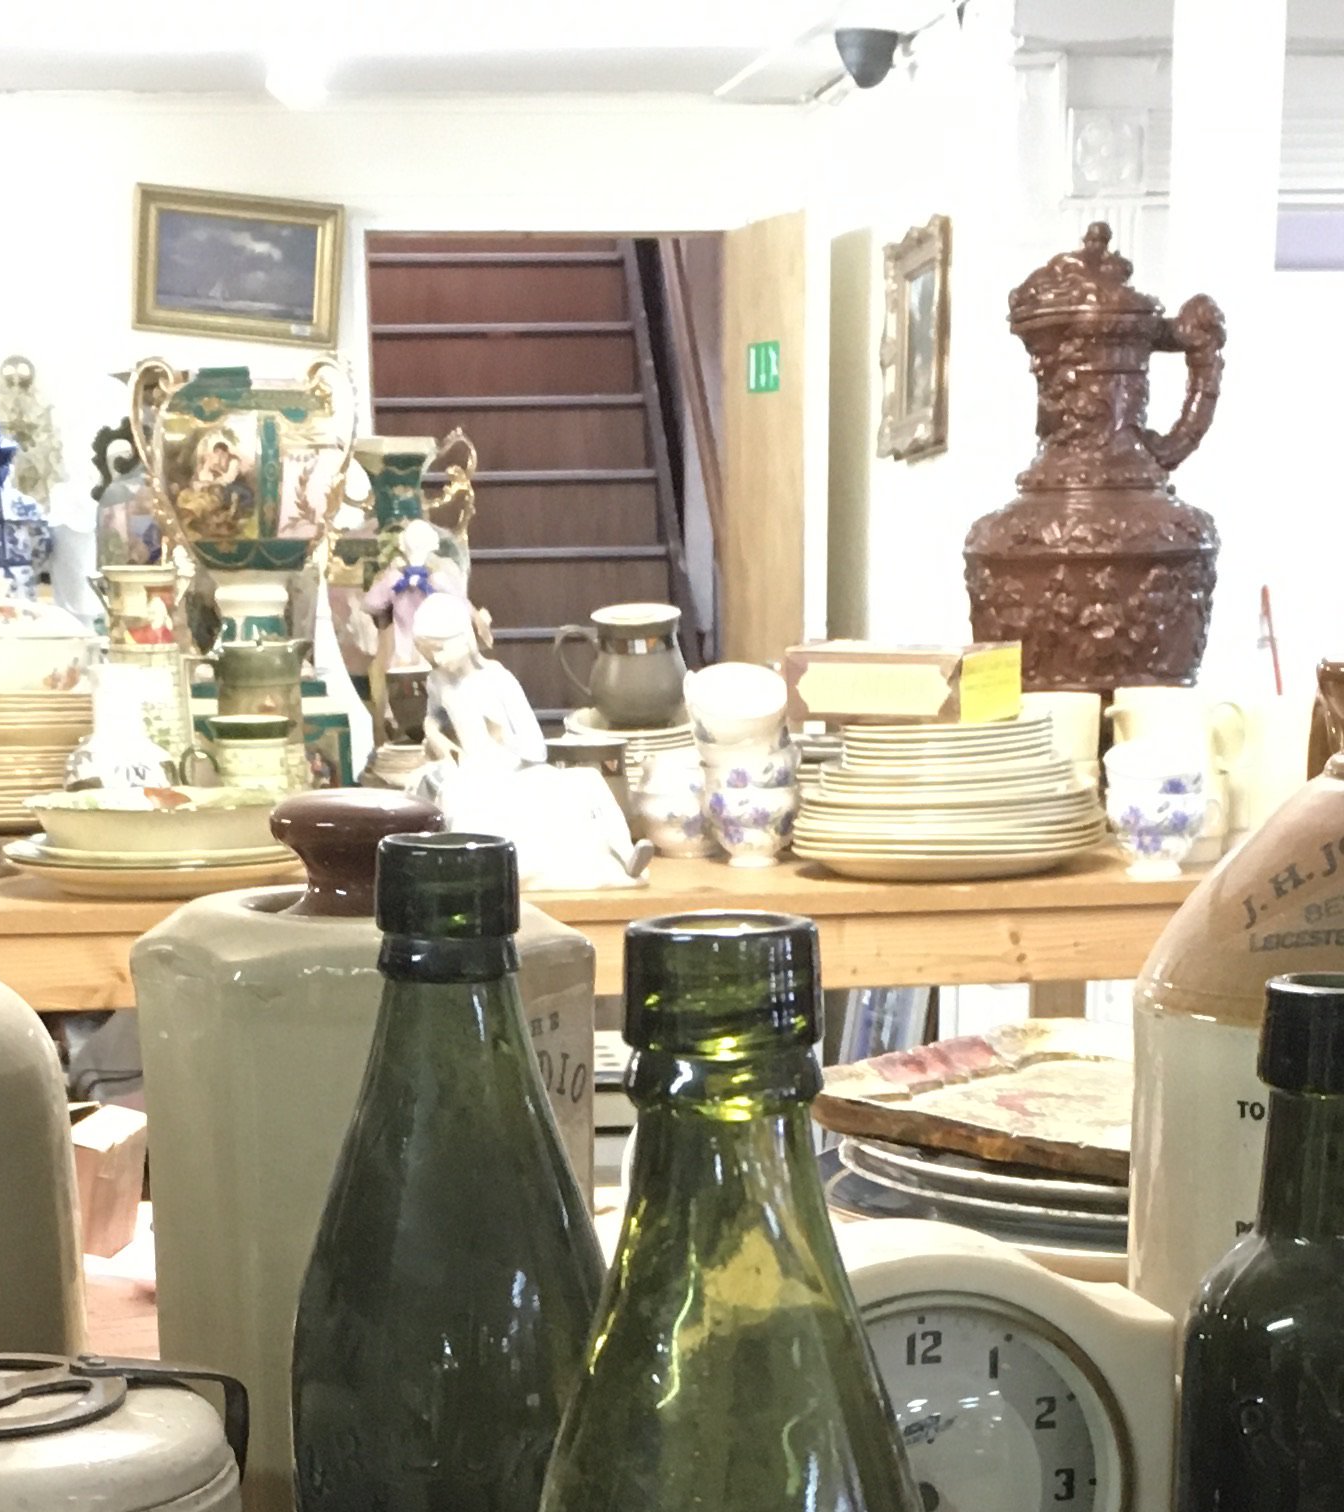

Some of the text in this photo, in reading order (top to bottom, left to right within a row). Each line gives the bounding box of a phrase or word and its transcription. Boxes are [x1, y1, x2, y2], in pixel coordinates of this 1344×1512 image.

[1237, 1102, 1265, 1121] TO
[905, 1330, 942, 1365] 12
[988, 1346, 999, 1379] 1
[1034, 1396, 1057, 1429] 2
[1053, 1468, 1075, 1501] 3
